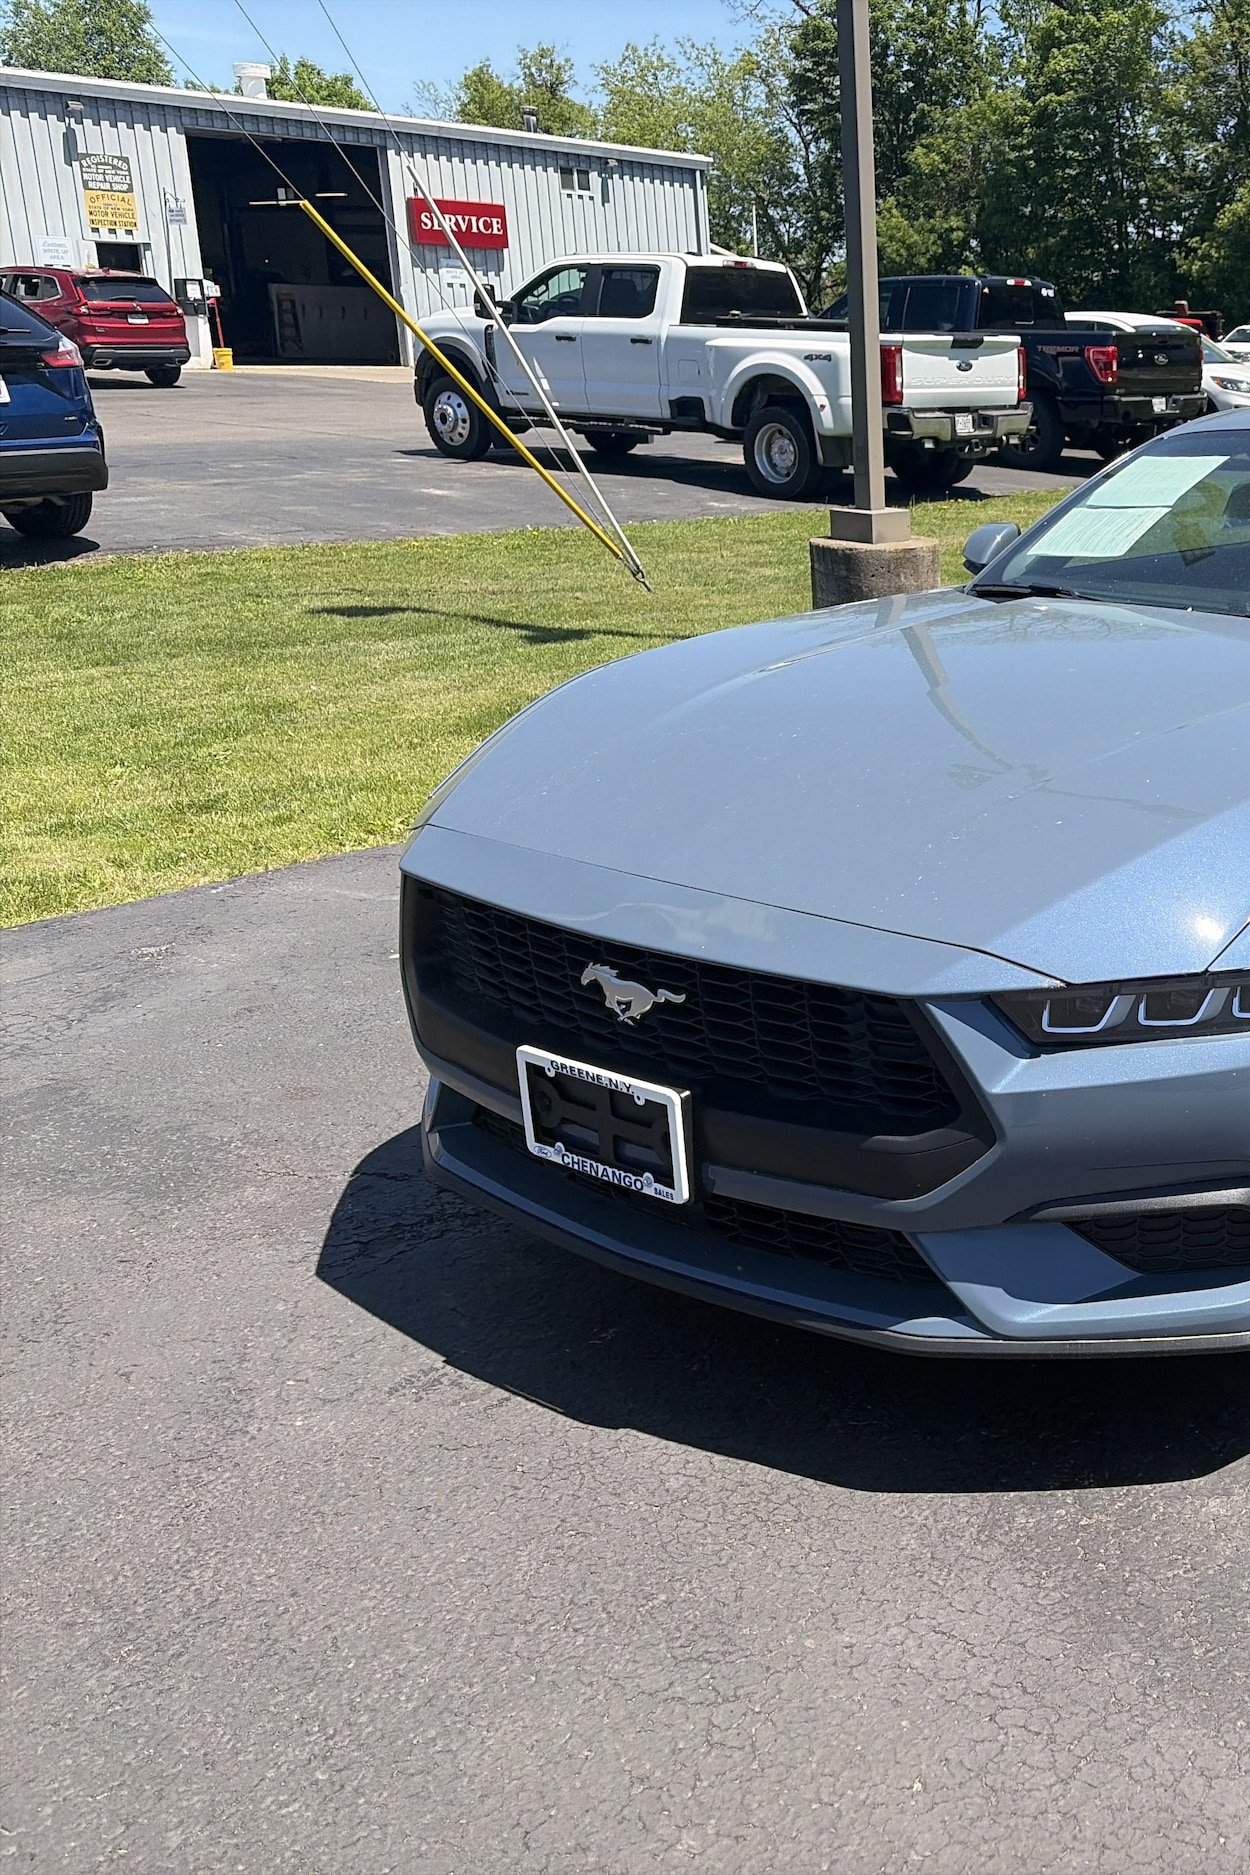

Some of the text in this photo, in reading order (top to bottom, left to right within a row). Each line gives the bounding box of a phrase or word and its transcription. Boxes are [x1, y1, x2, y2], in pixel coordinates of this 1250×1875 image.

[81, 155, 128, 170] REGISTERED
[83, 173, 130, 184] MOTOR VEHICLE
[88, 181, 128, 191] REPAIR SHOP
[90, 194, 132, 206] OFFICIAL
[89, 210, 135, 220] MOTOR VEHICLE
[90, 219, 117, 227] INSPECTION
[1036, 345, 1080, 353] TREMOR
[911, 375, 1014, 386] SUPER DUTY
[536, 1147, 552, 1158] Ford
[561, 1154, 644, 1192] CHENANGO
[653, 1187, 675, 1201] SALES
